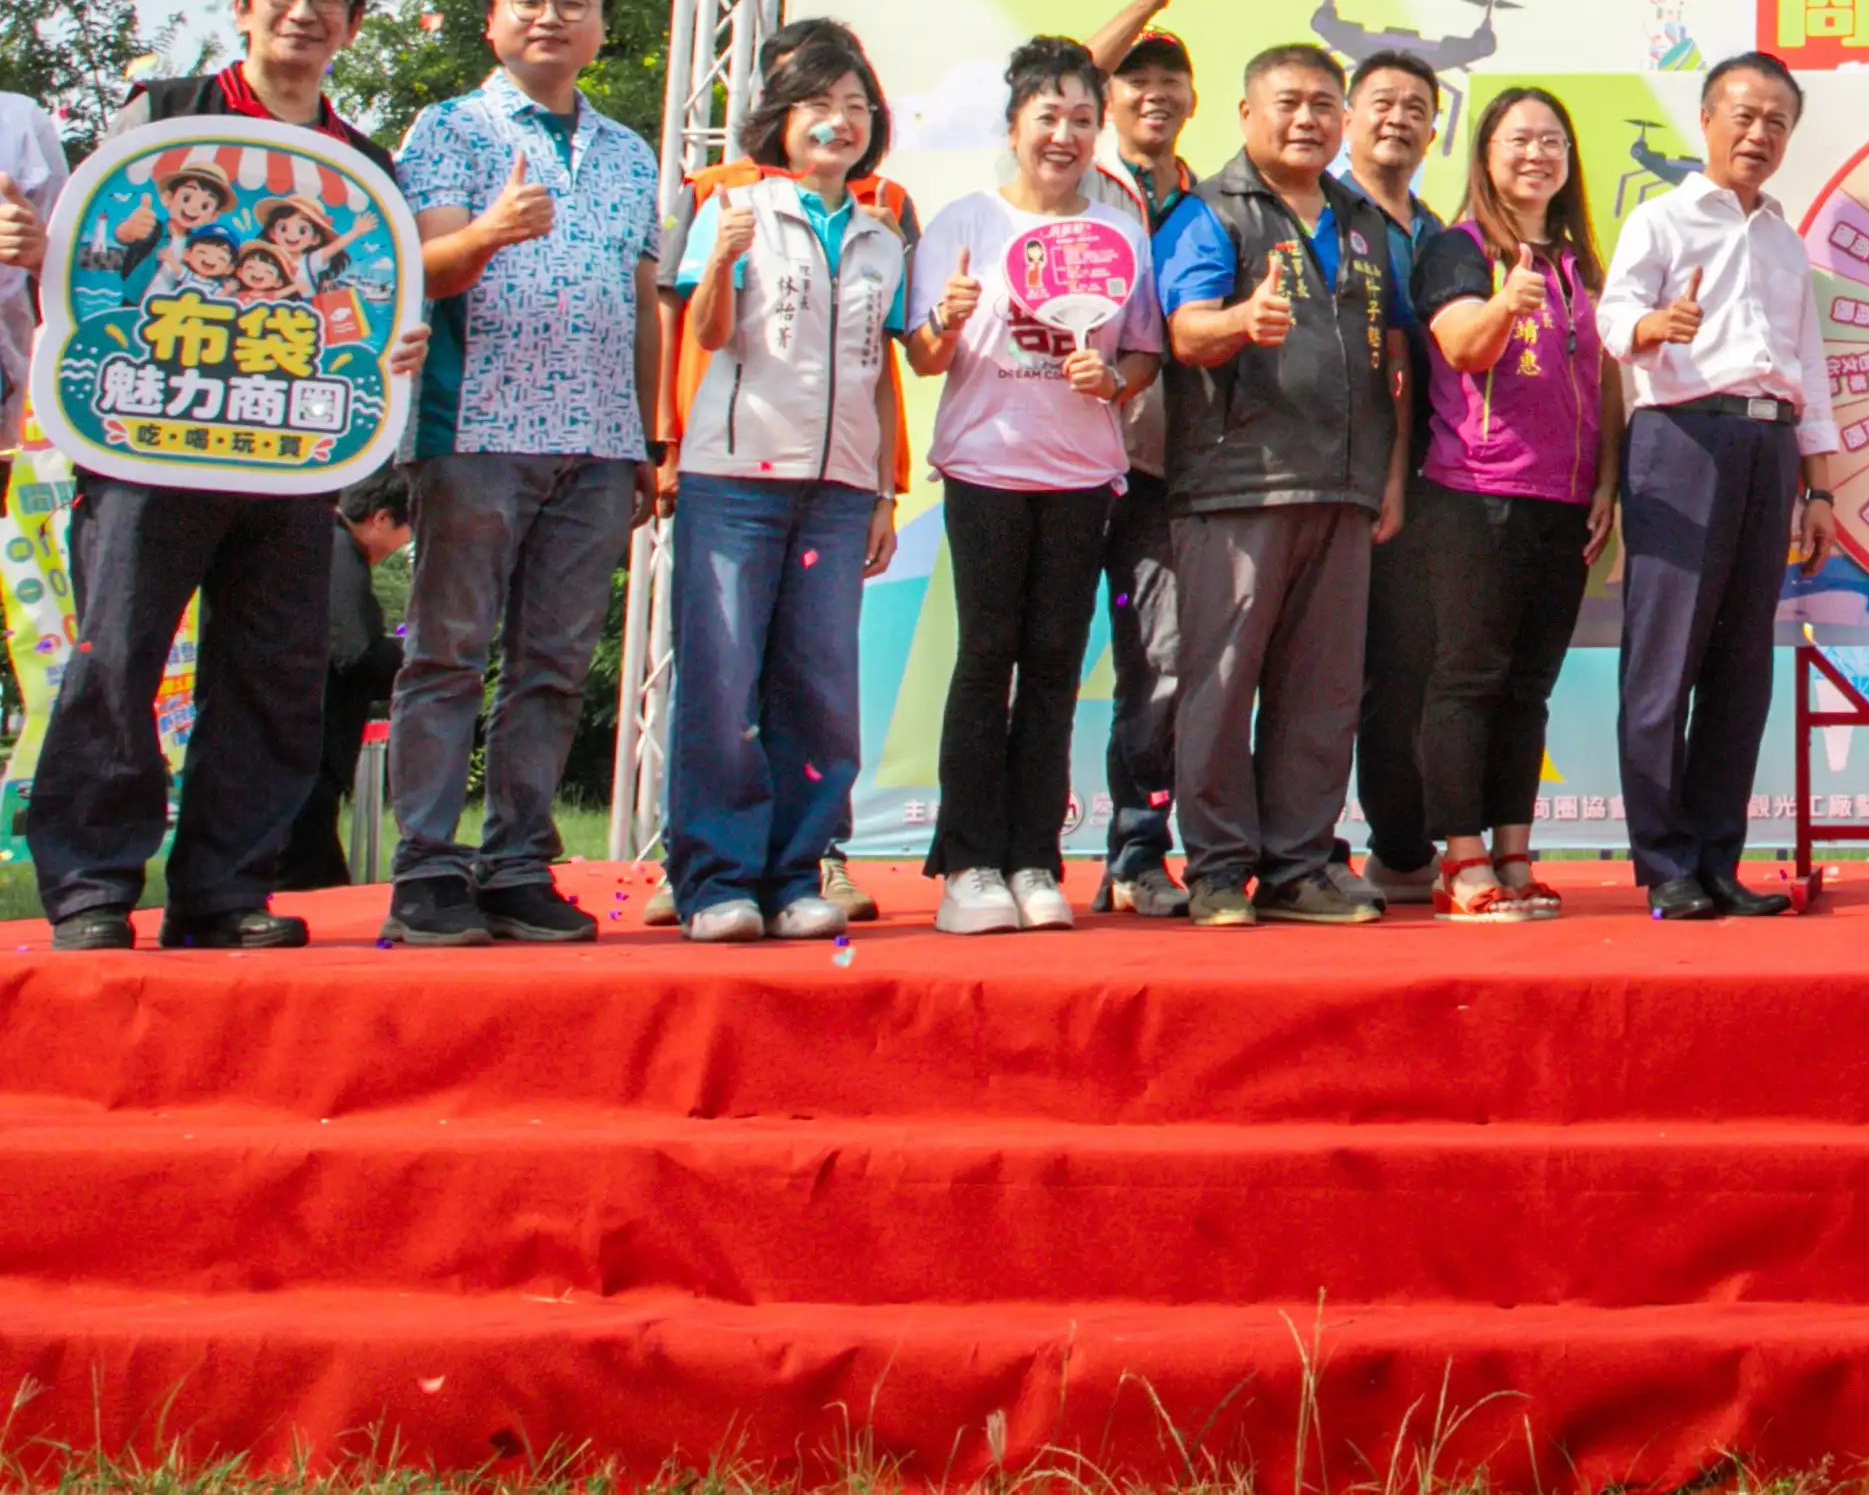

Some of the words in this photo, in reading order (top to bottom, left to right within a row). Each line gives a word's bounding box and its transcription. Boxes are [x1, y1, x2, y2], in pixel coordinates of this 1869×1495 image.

[143, 293, 321, 376] 布袋
[100, 360, 348, 431] 魅力商圈
